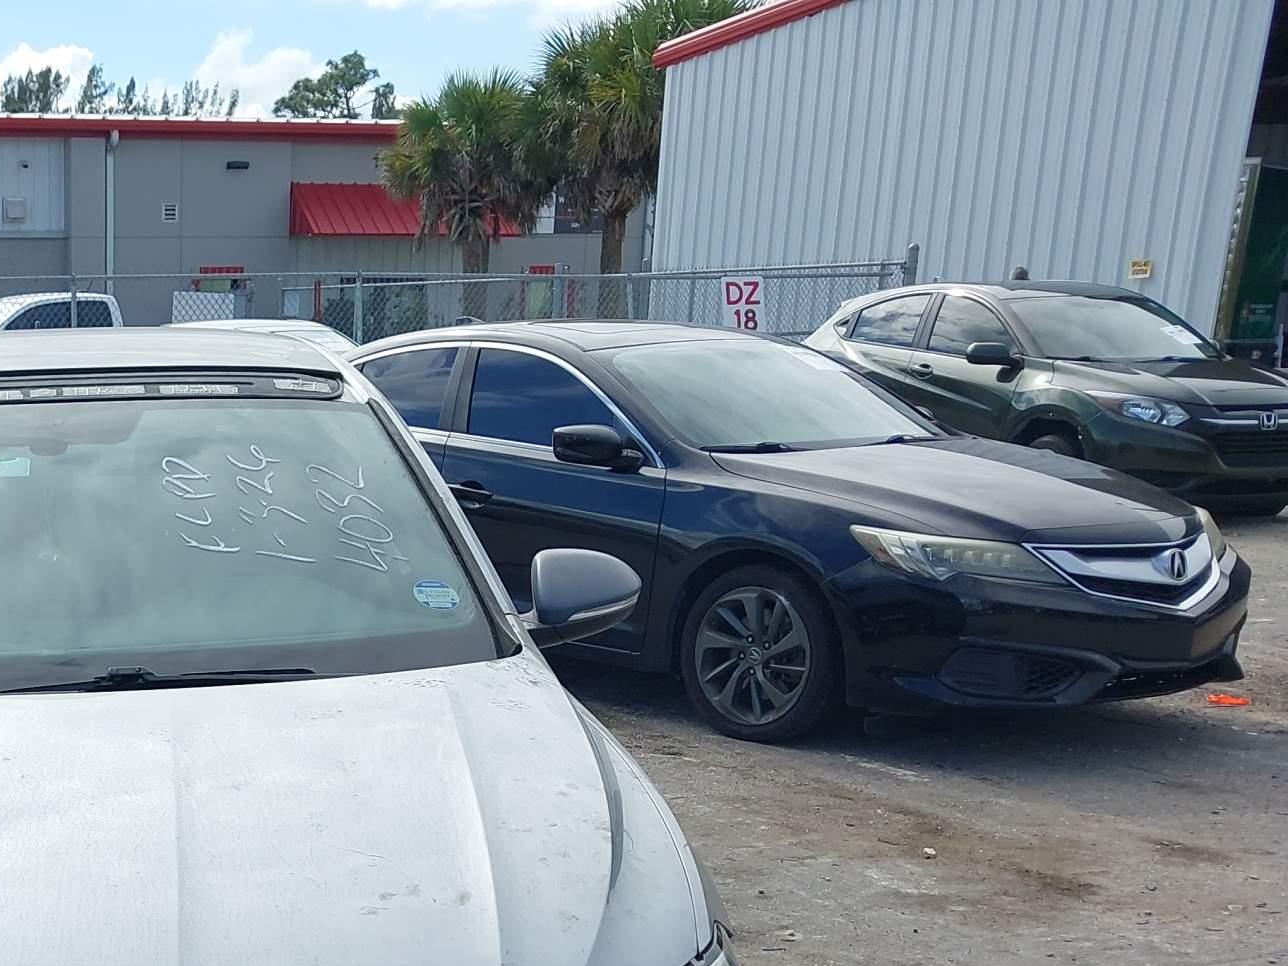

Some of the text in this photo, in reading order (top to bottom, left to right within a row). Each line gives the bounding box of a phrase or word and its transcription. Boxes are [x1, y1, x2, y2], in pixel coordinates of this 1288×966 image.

[725, 281, 761, 305] DZ
[734, 308, 758, 331] 18
[306, 463, 410, 573] 4032
